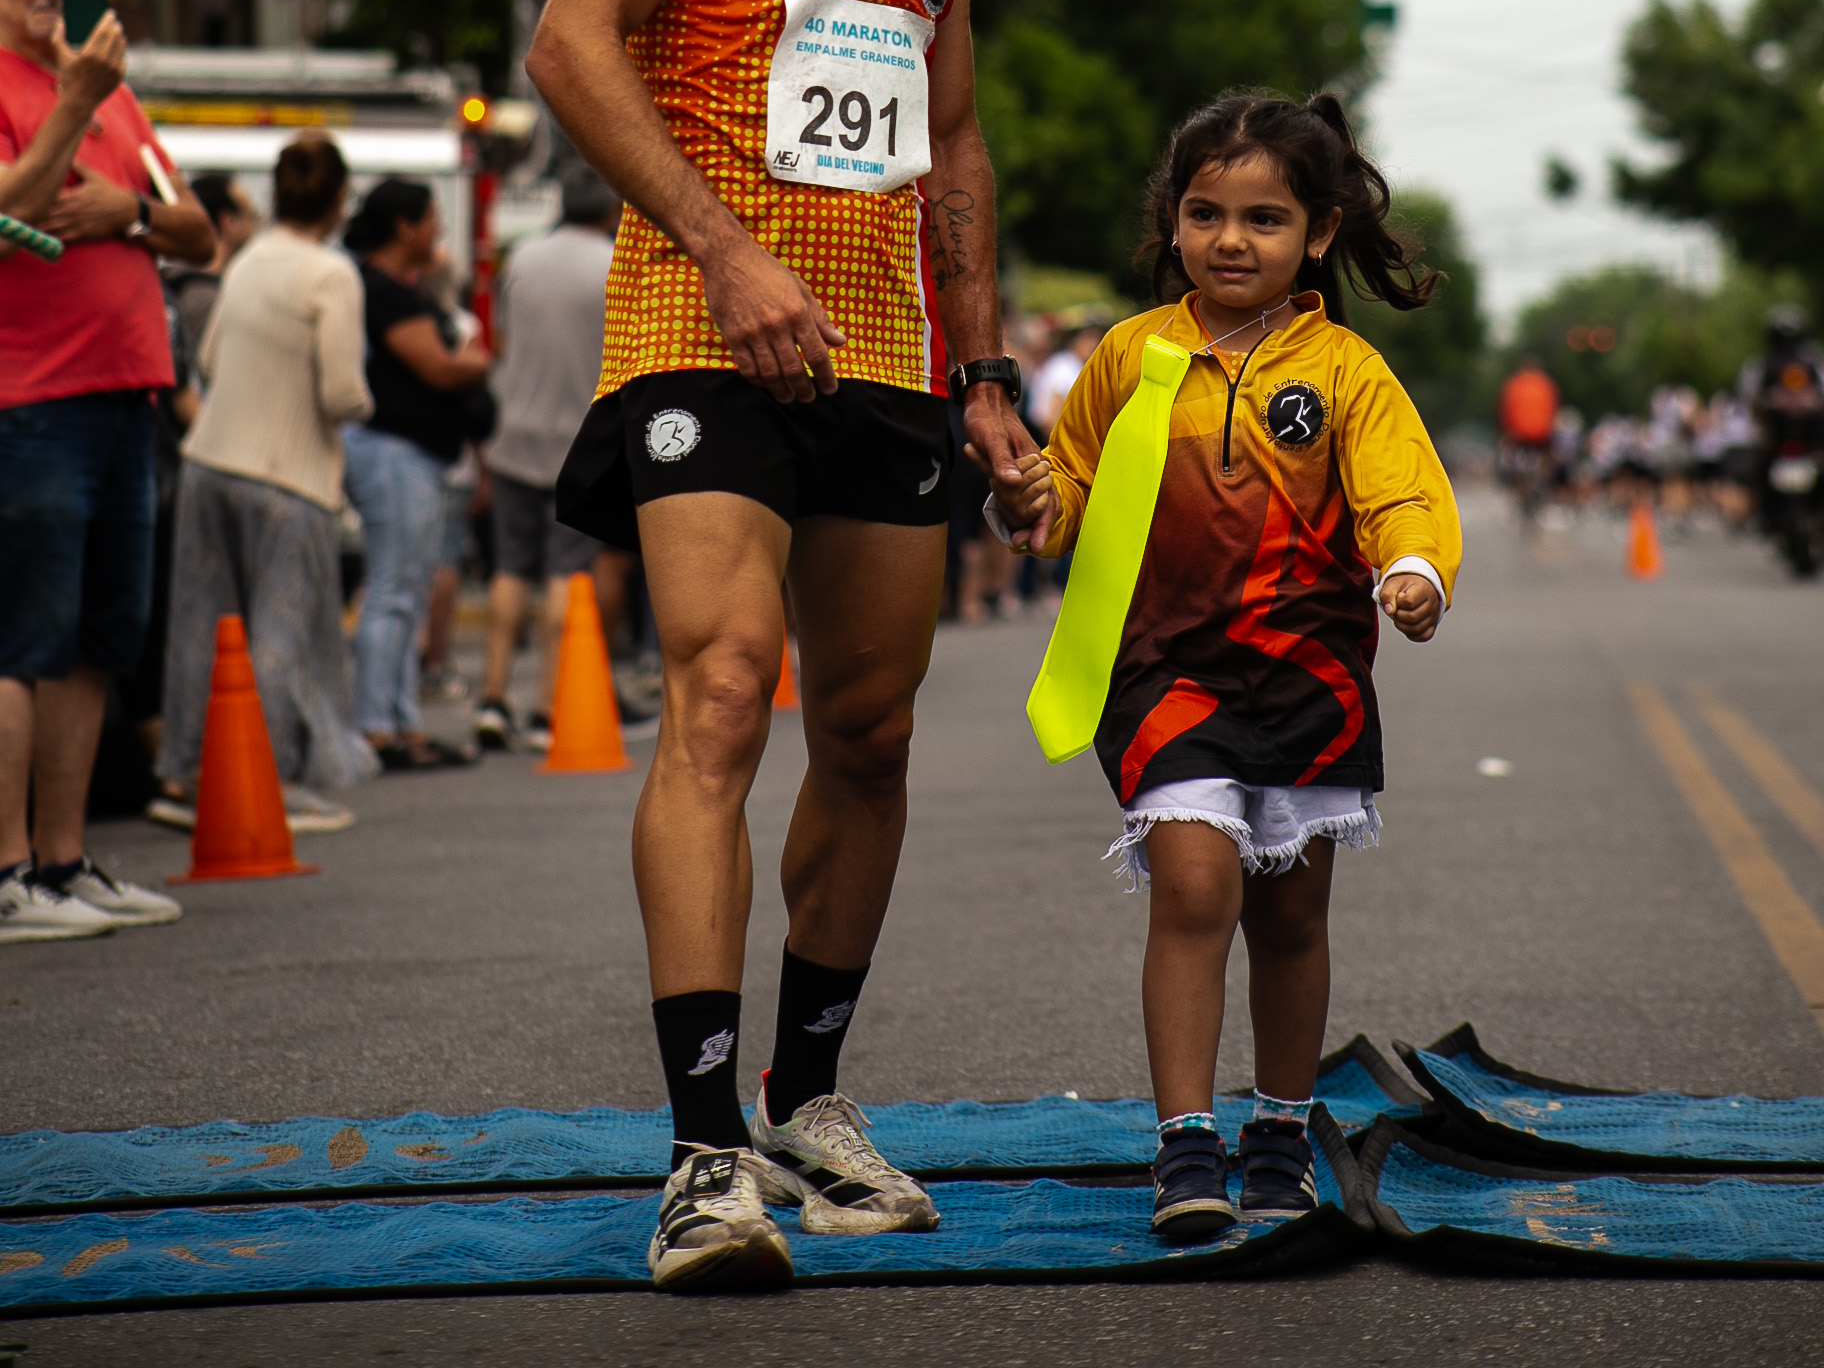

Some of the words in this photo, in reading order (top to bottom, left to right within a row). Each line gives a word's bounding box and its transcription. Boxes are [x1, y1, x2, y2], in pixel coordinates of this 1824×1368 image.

[804, 17, 825, 34] 40
[832, 20, 912, 49] MARATON
[796, 41, 856, 59] EMPALME
[860, 50, 916, 70] GRANEROS
[799, 85, 898, 157] 291
[773, 150, 800, 167] NEJ
[817, 154, 833, 168] DIA
[835, 157, 850, 170] DEL
[852, 160, 885, 175] VECINO
[1262, 391, 1274, 403] de
[1260, 405, 1273, 439] Grupo
